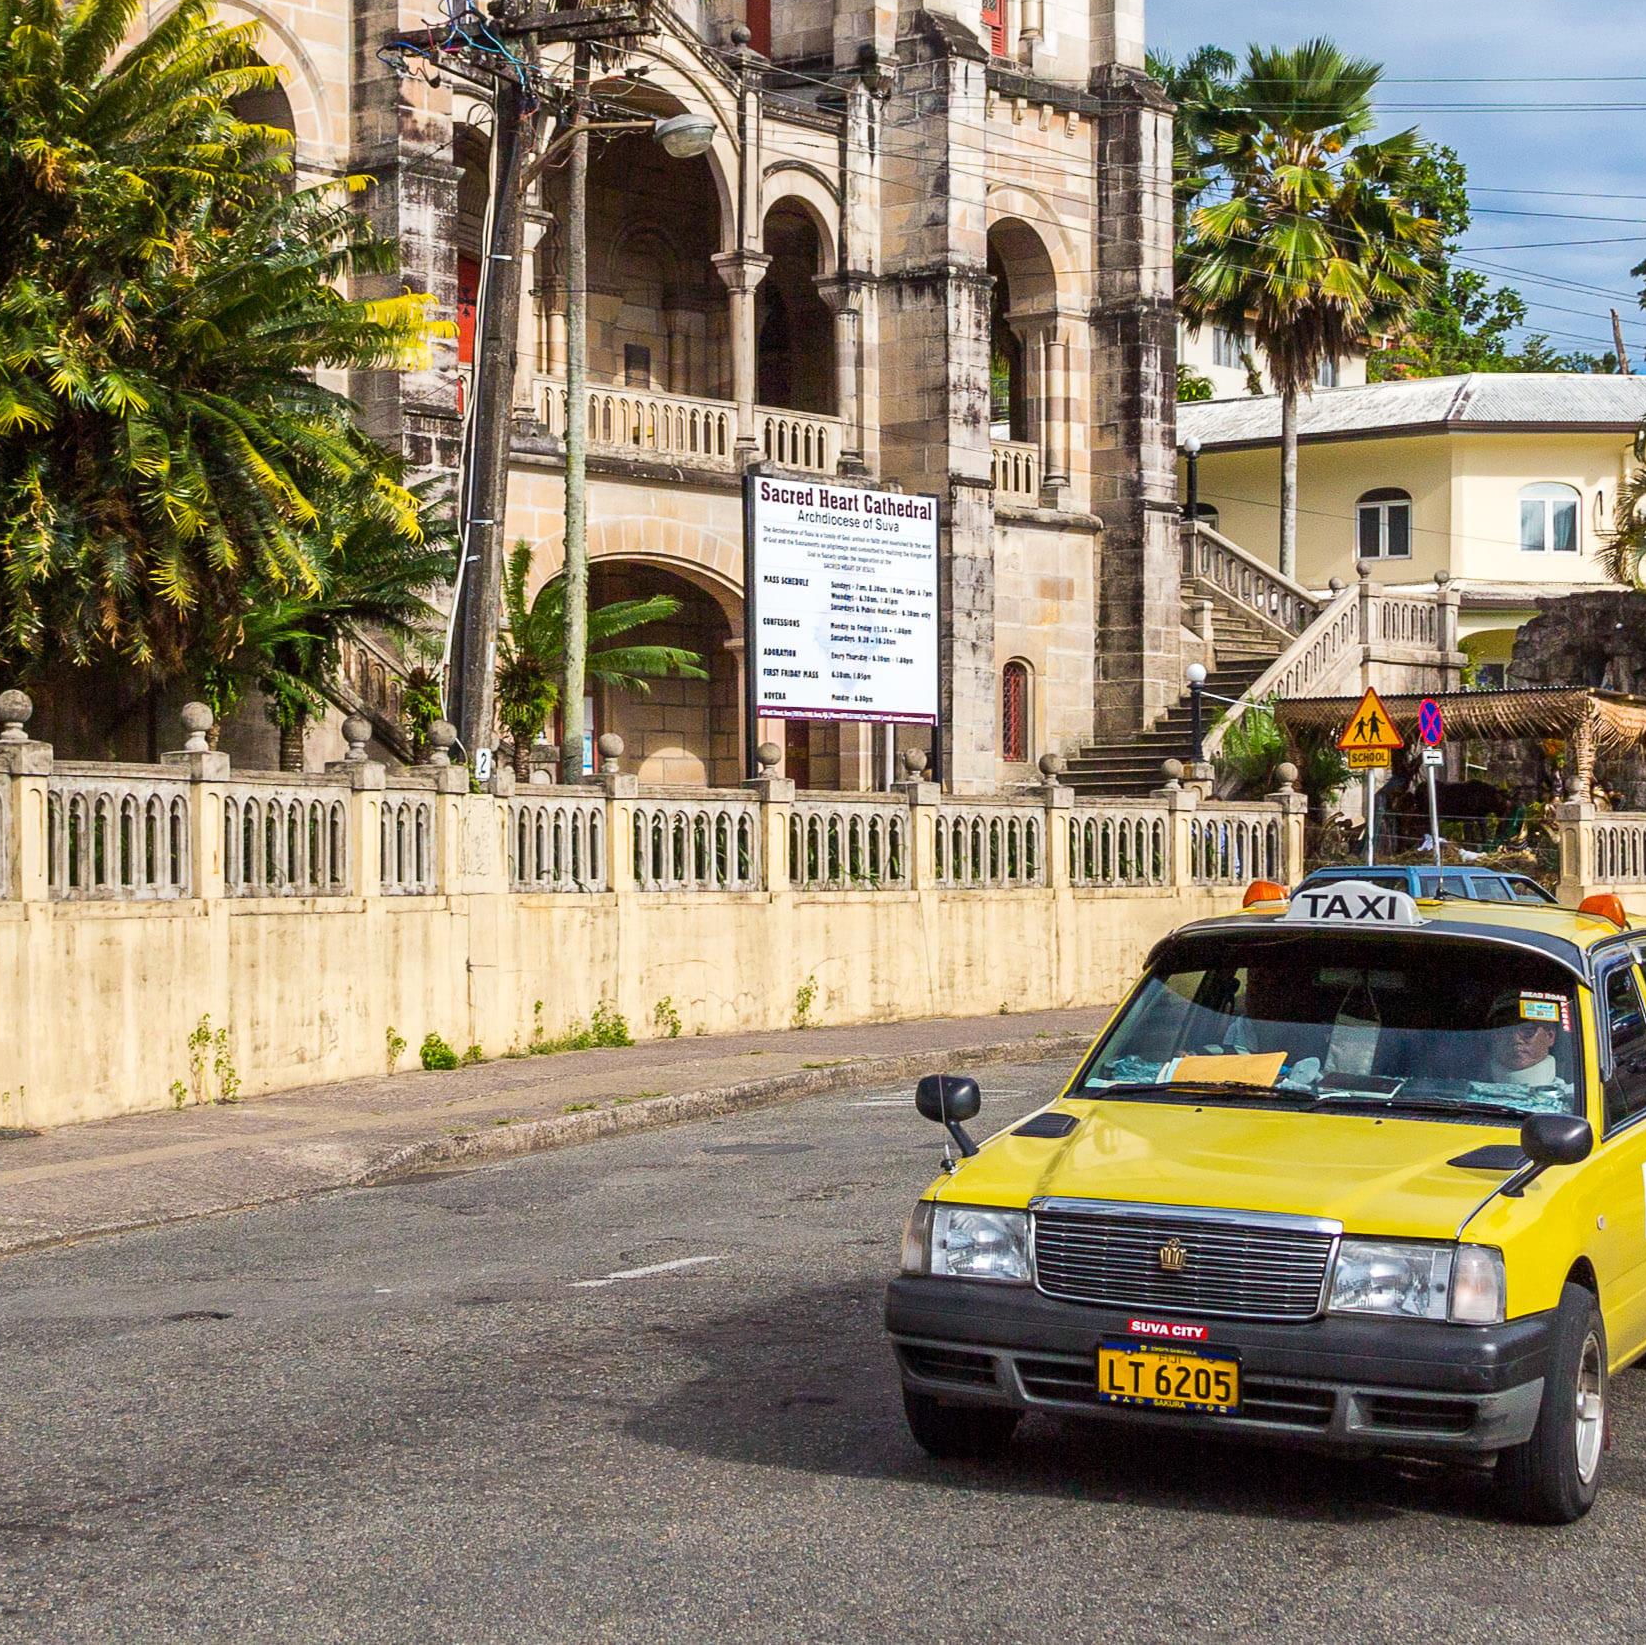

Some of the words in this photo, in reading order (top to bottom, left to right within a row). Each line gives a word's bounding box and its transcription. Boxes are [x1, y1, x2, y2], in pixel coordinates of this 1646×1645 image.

[761, 481, 814, 507] Sacred
[819, 489, 859, 512] Heart
[864, 494, 932, 521] Cathedral
[797, 509, 860, 527] Archdiocese
[863, 517, 873, 529] of
[875, 518, 900, 532] Suva
[764, 575, 779, 584] MASS
[781, 577, 809, 586] SCHEDULE
[763, 617, 800, 628] CONFESSIONS
[763, 648, 796, 657] ADORATION
[763, 668, 779, 676] FIRST
[781, 669, 801, 678] FRIDAY
[803, 671, 819, 679] MASS
[764, 692, 786, 700] NOVENA
[481, 752, 487, 774] 2
[1351, 752, 1387, 763] SCHOOL
[1301, 894, 1397, 920] TAXI
[1131, 1321, 1169, 1335] SUVA
[1172, 1326, 1204, 1338] CITY
[1158, 1353, 1181, 1364] FIJI
[1108, 1358, 1145, 1393] LT
[1155, 1364, 1231, 1402] 6205
[1154, 1398, 1186, 1409] SAKURA
